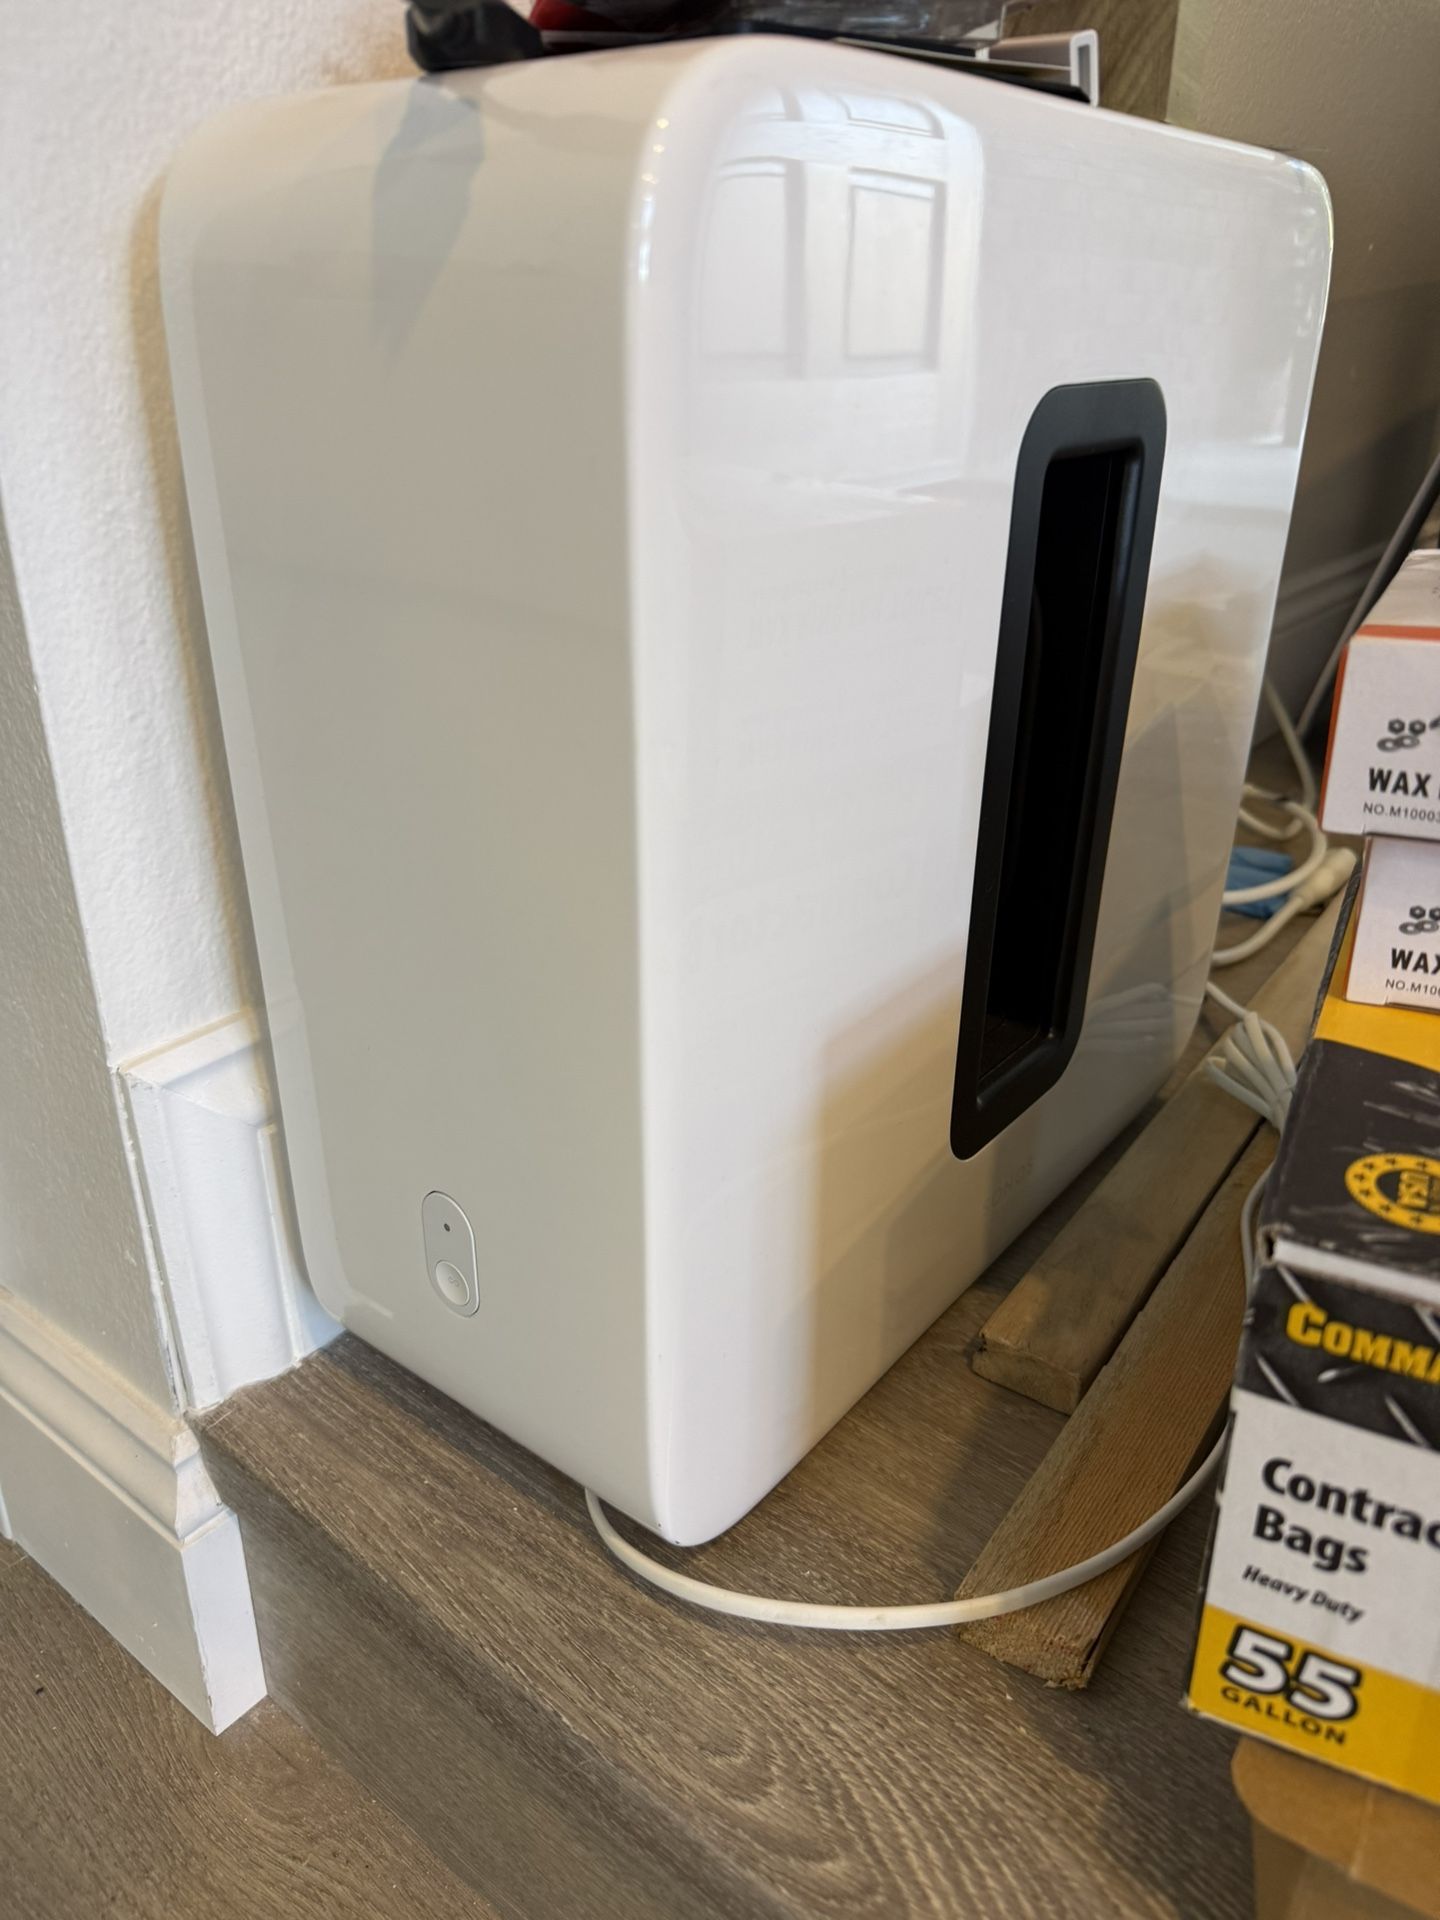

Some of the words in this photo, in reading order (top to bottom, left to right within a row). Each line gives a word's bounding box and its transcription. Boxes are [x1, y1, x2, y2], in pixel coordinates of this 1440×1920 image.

[1369, 767, 1432, 798] WAX
[1253, 1504, 1369, 1573] Bags
[1242, 1565, 1309, 1604] Heavy
[1310, 1590, 1365, 1623] Duty
[1219, 1624, 1362, 1722] 55
[1220, 1686, 1346, 1756] GALLON
